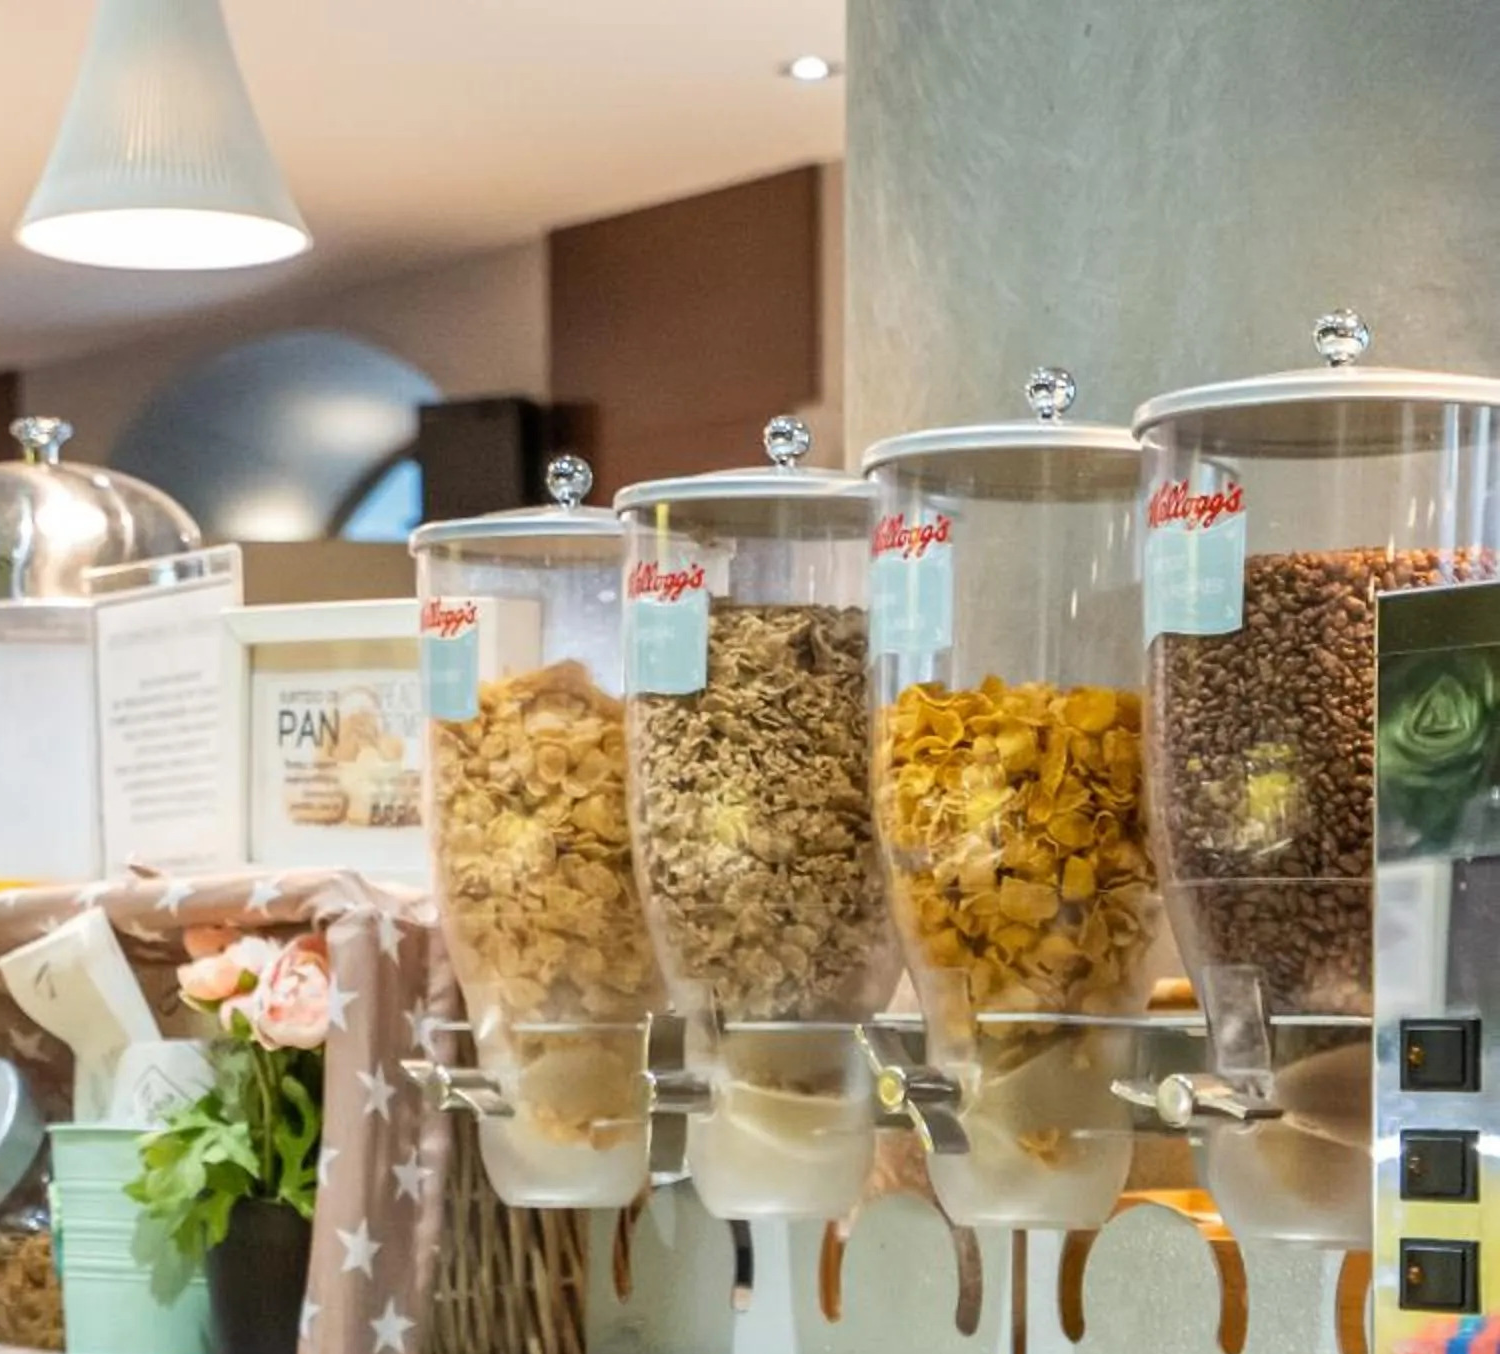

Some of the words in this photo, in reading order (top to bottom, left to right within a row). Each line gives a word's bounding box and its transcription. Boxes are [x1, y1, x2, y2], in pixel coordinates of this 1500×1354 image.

[1148, 478, 1246, 530] Kellogg's
[871, 513, 952, 560] Kellogg's
[278, 708, 340, 748] PAN
